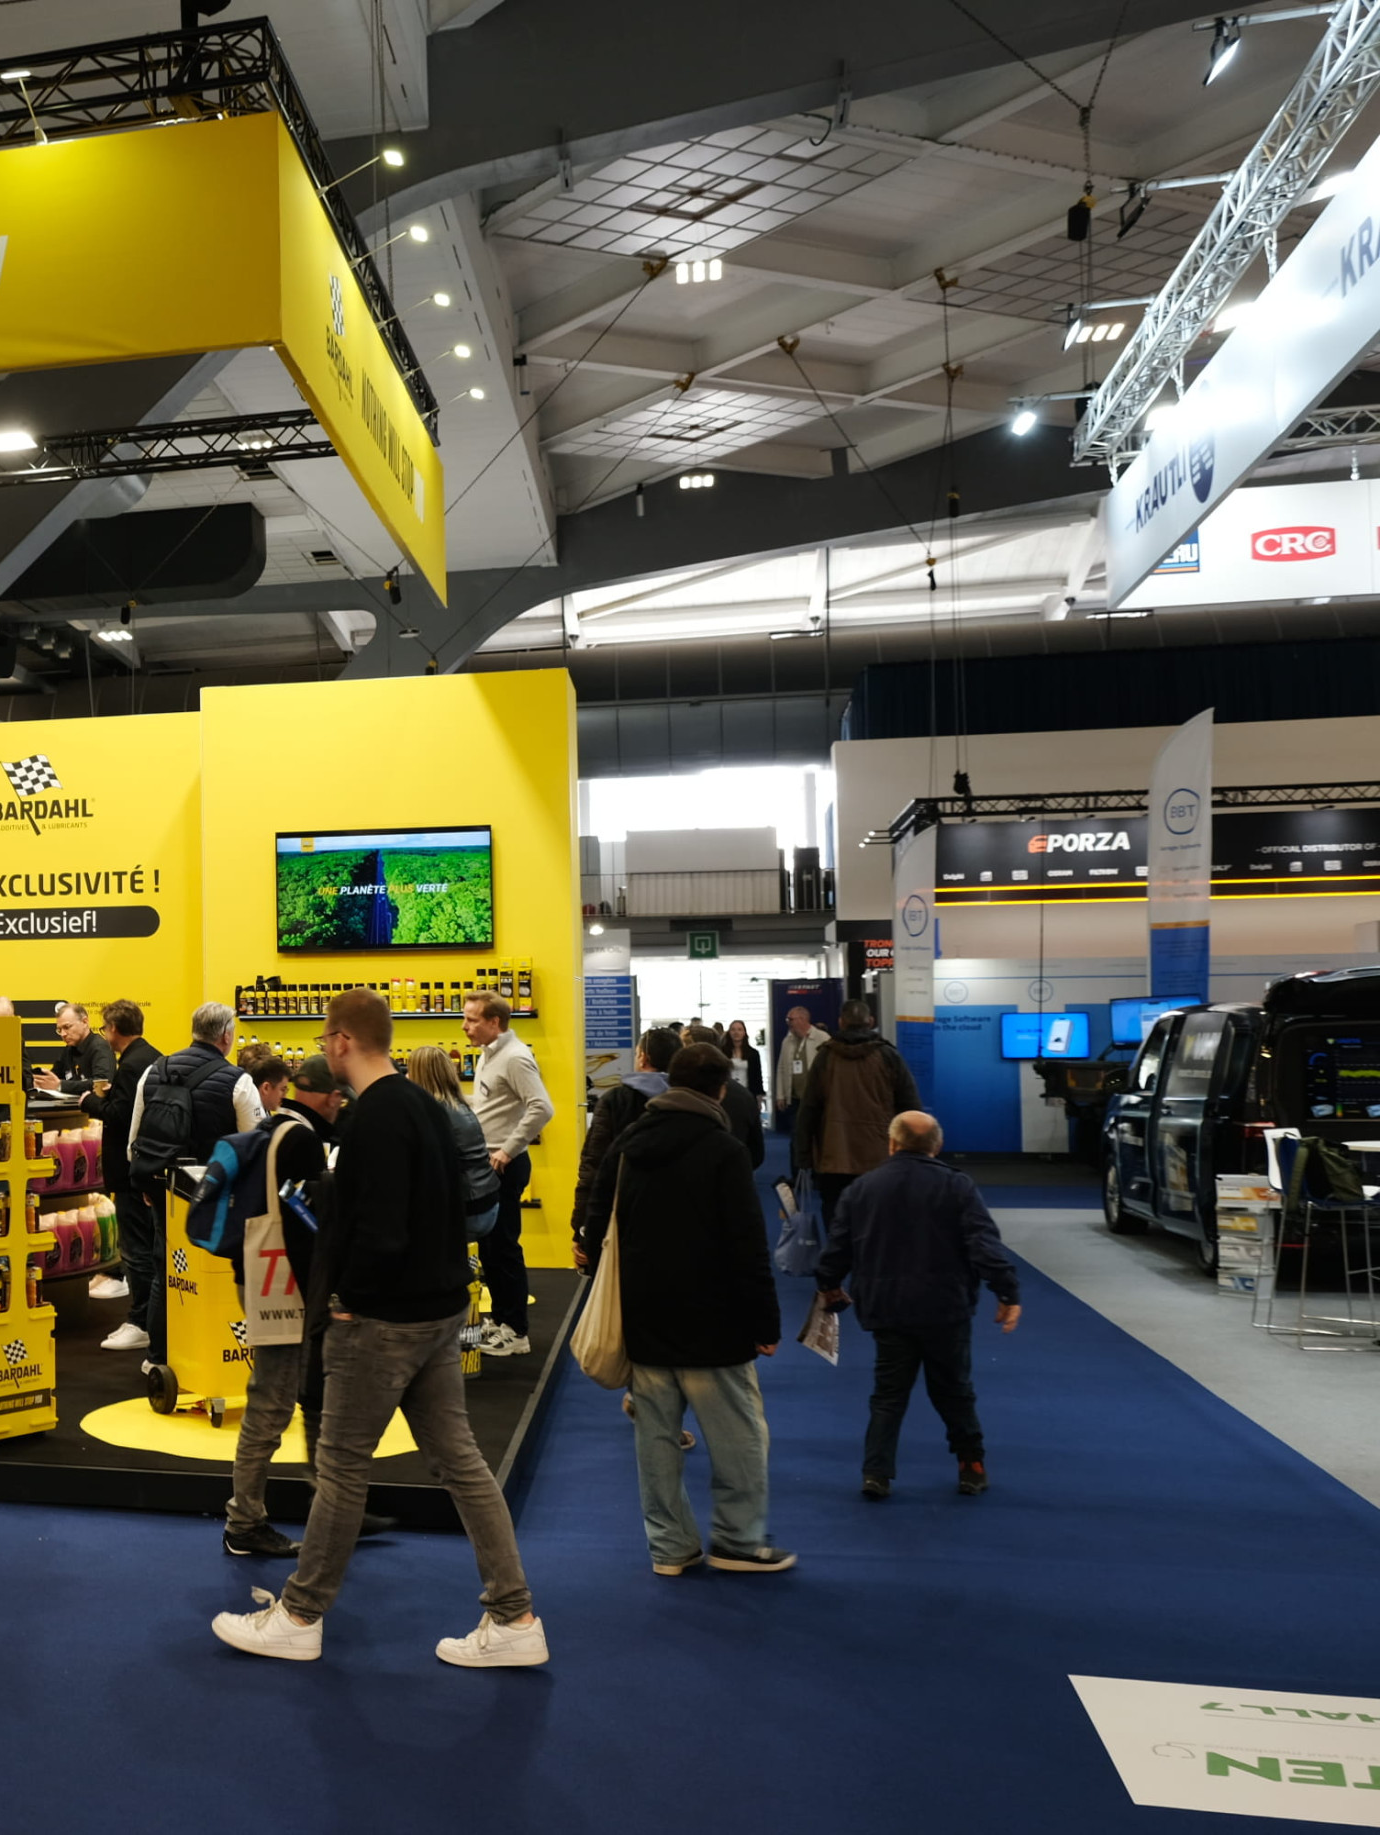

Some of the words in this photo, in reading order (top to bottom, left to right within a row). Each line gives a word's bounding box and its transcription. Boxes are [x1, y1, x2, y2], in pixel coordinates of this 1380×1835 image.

[1340, 215, 1380, 299] KR
[1254, 532, 1333, 559] CRC
[168, 1275, 198, 1296] BARDAHL
